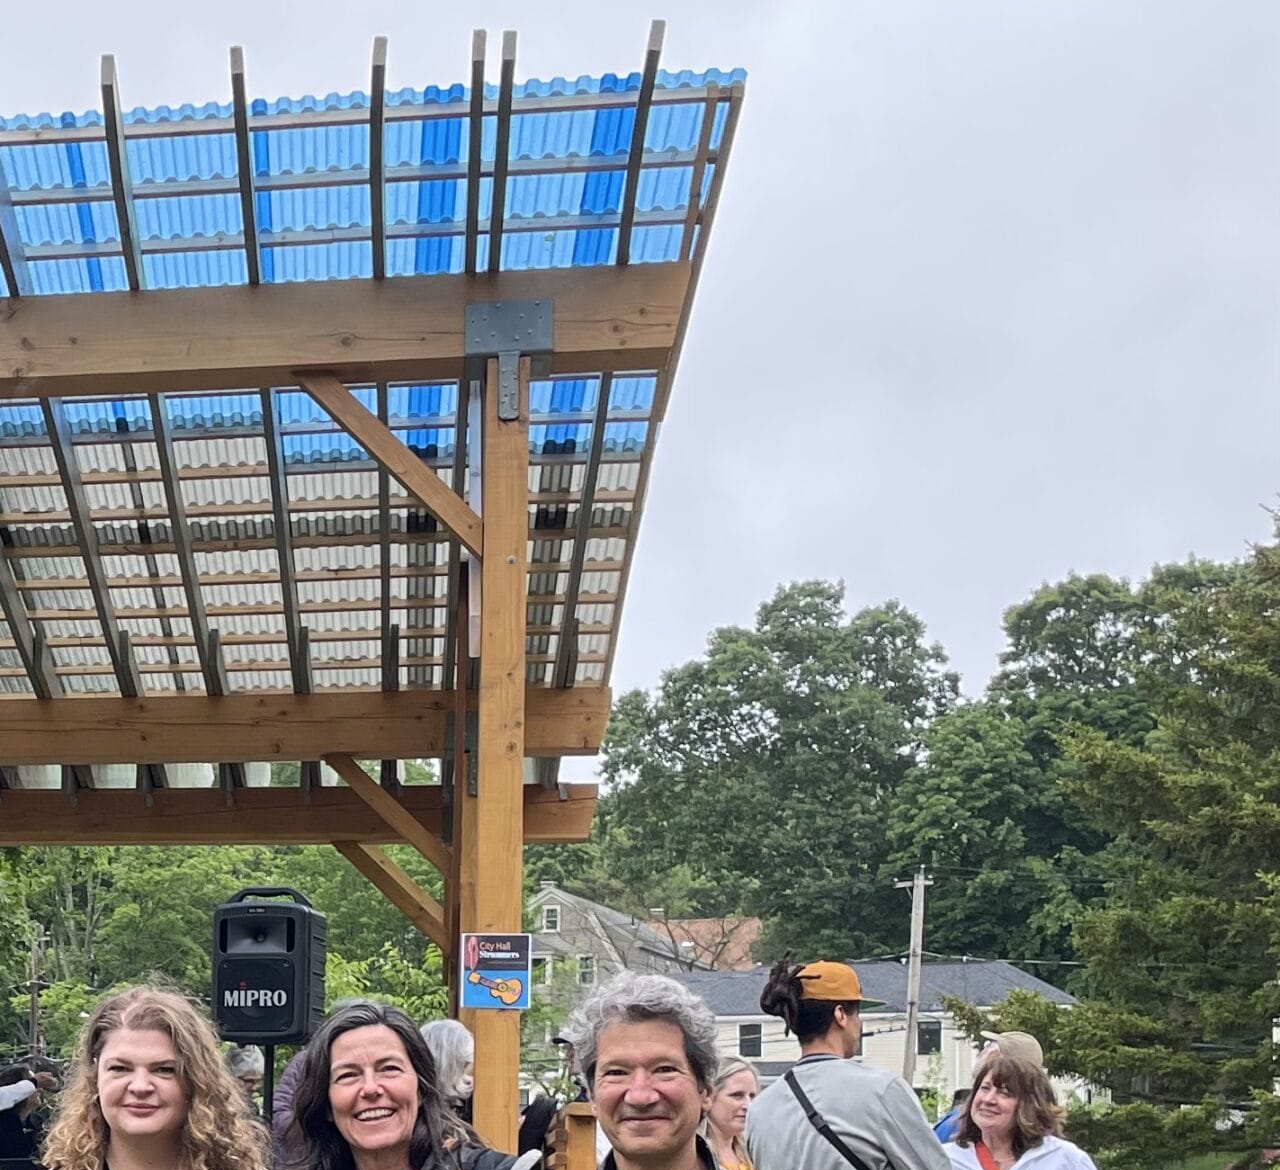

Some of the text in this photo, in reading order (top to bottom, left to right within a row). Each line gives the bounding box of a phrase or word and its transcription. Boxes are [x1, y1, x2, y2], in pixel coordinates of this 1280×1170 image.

[479, 942, 511, 951] City Hall
[224, 989, 287, 1007] MIPRO
